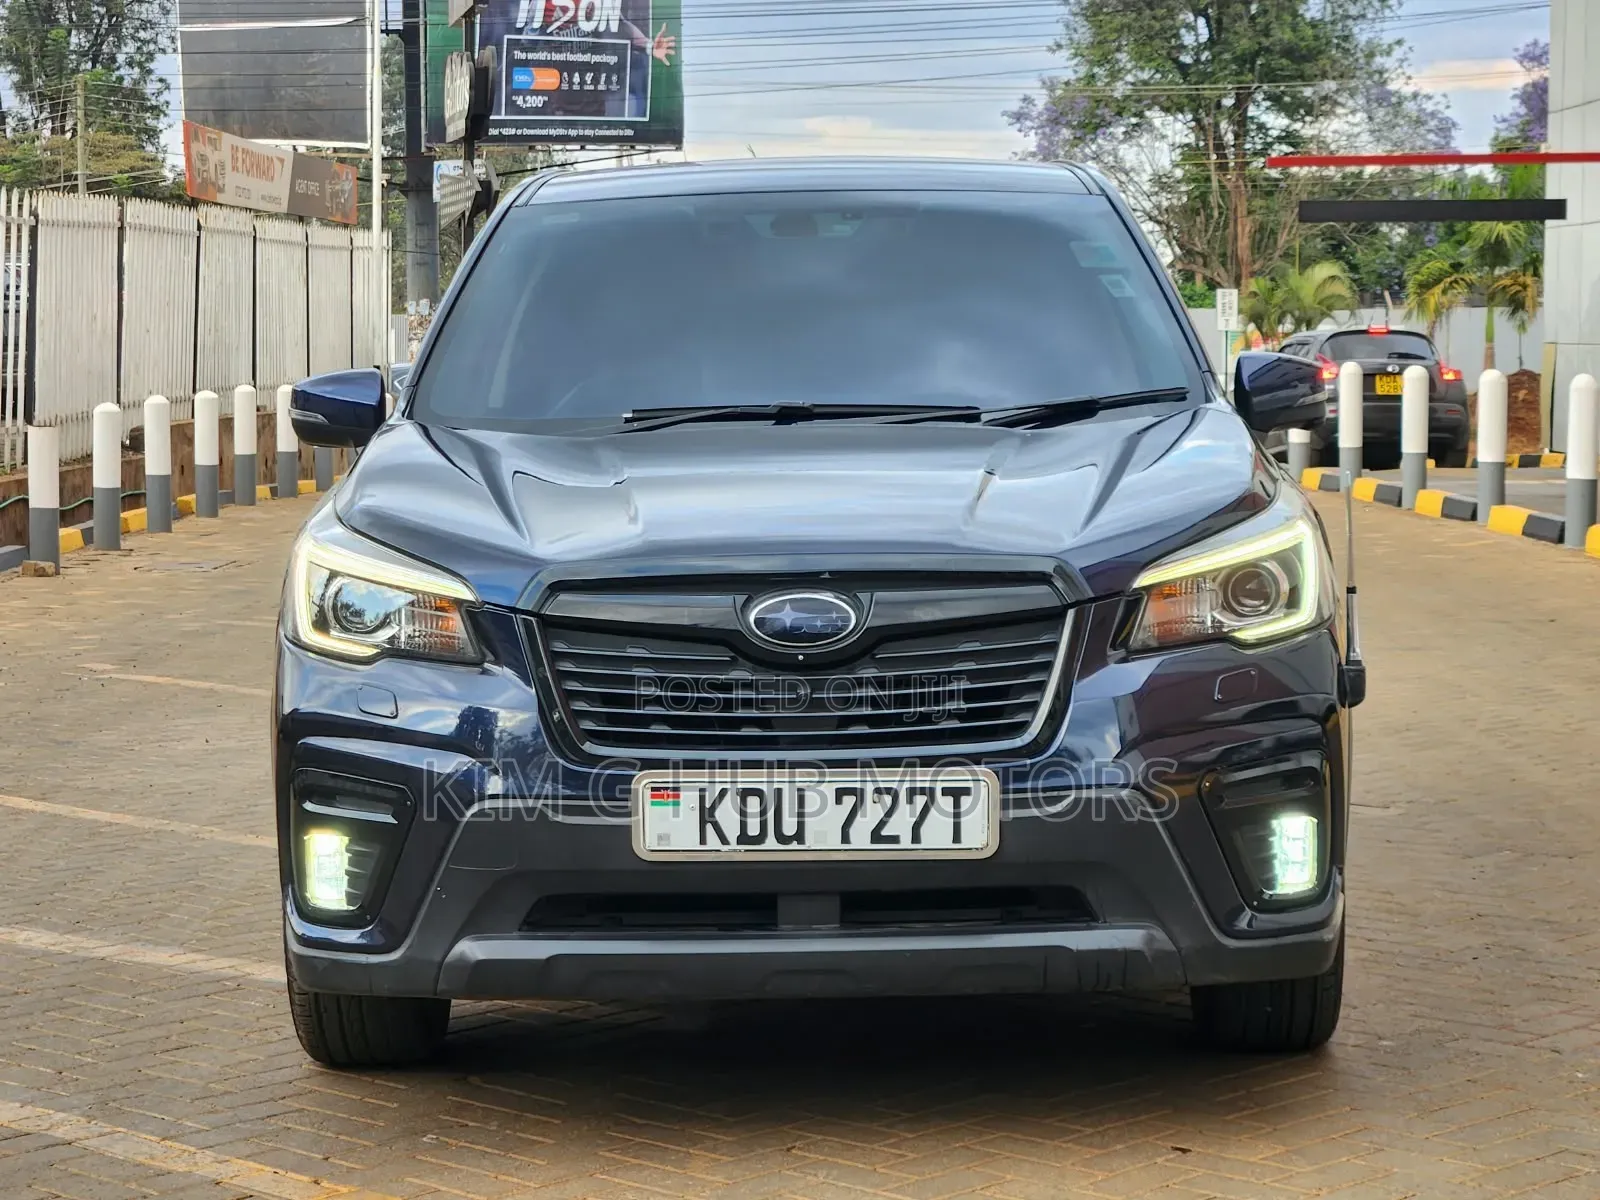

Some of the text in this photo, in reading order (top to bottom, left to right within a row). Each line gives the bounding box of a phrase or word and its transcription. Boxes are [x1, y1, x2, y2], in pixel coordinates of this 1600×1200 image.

[514, 50, 618, 65] The world's best football package
[568, 128, 579, 137] App
[231, 144, 275, 183] BE FORWARD
[699, 786, 972, 846] KDU 727T
